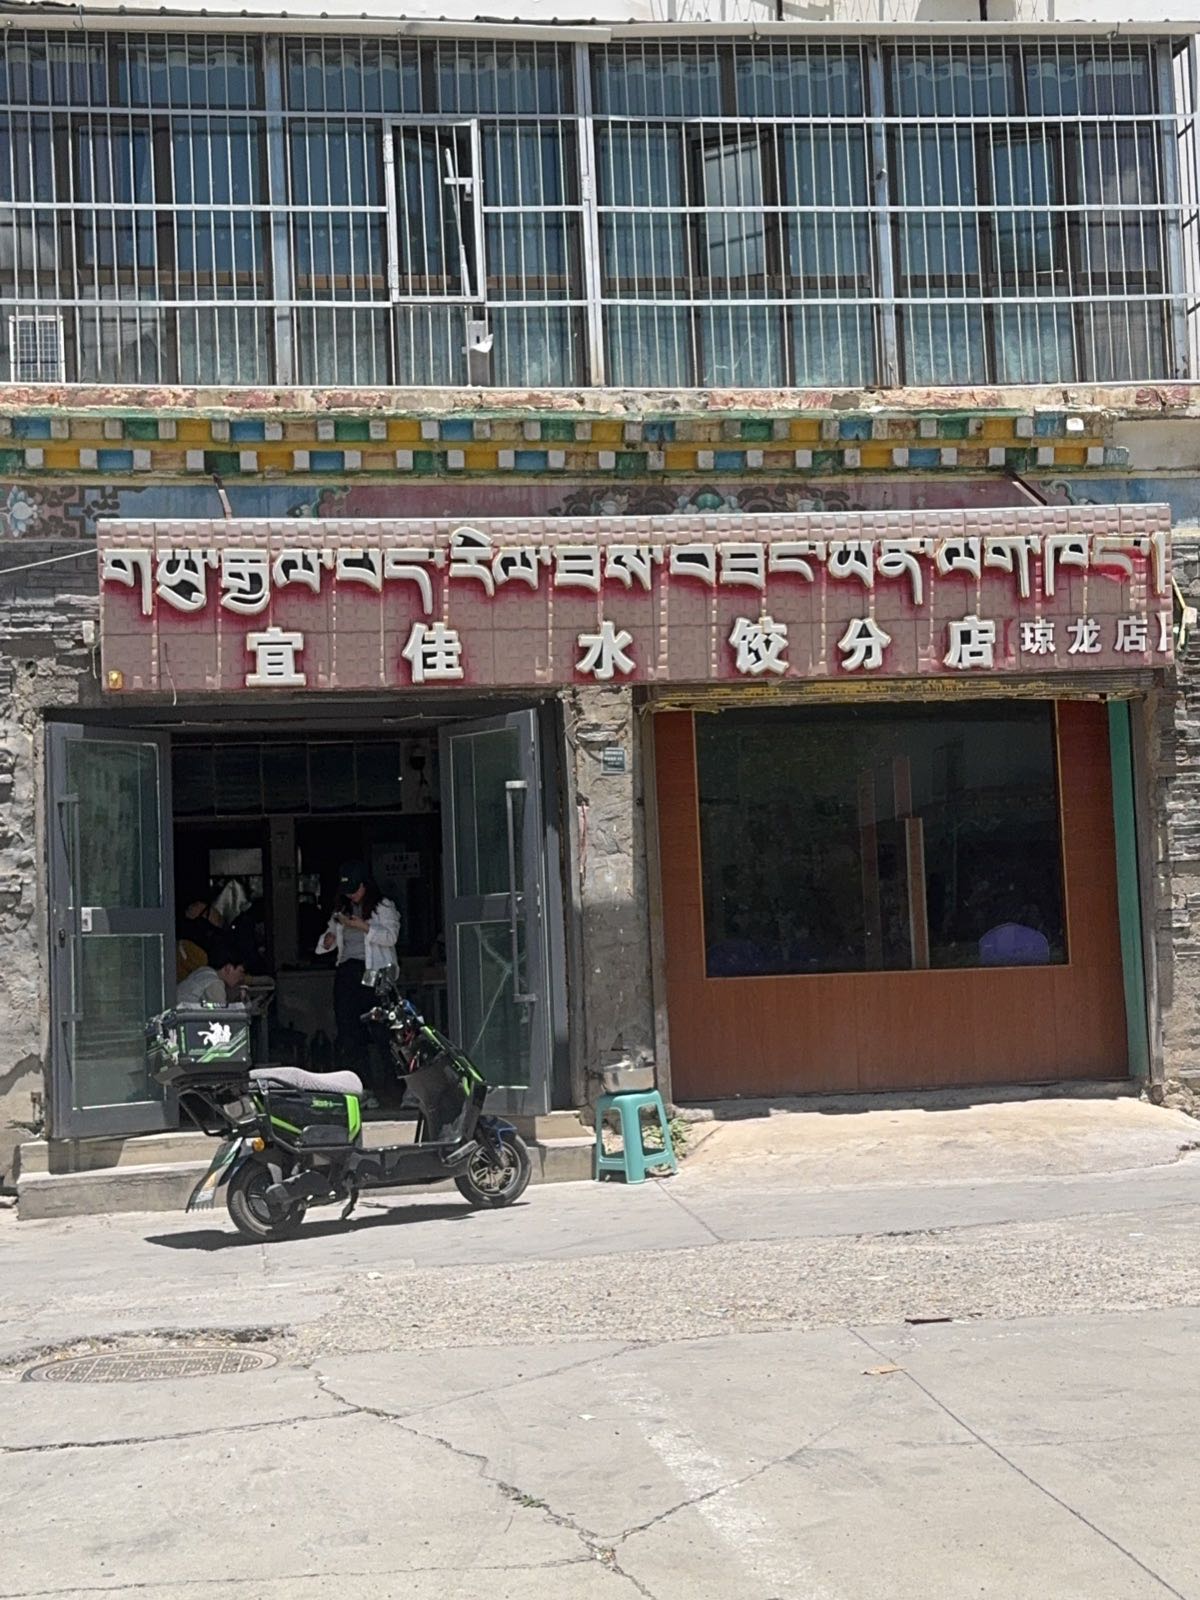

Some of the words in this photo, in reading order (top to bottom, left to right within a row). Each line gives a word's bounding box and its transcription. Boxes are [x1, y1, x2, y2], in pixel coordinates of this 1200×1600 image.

[245, 616, 995, 687] 宜佳水饺分店
